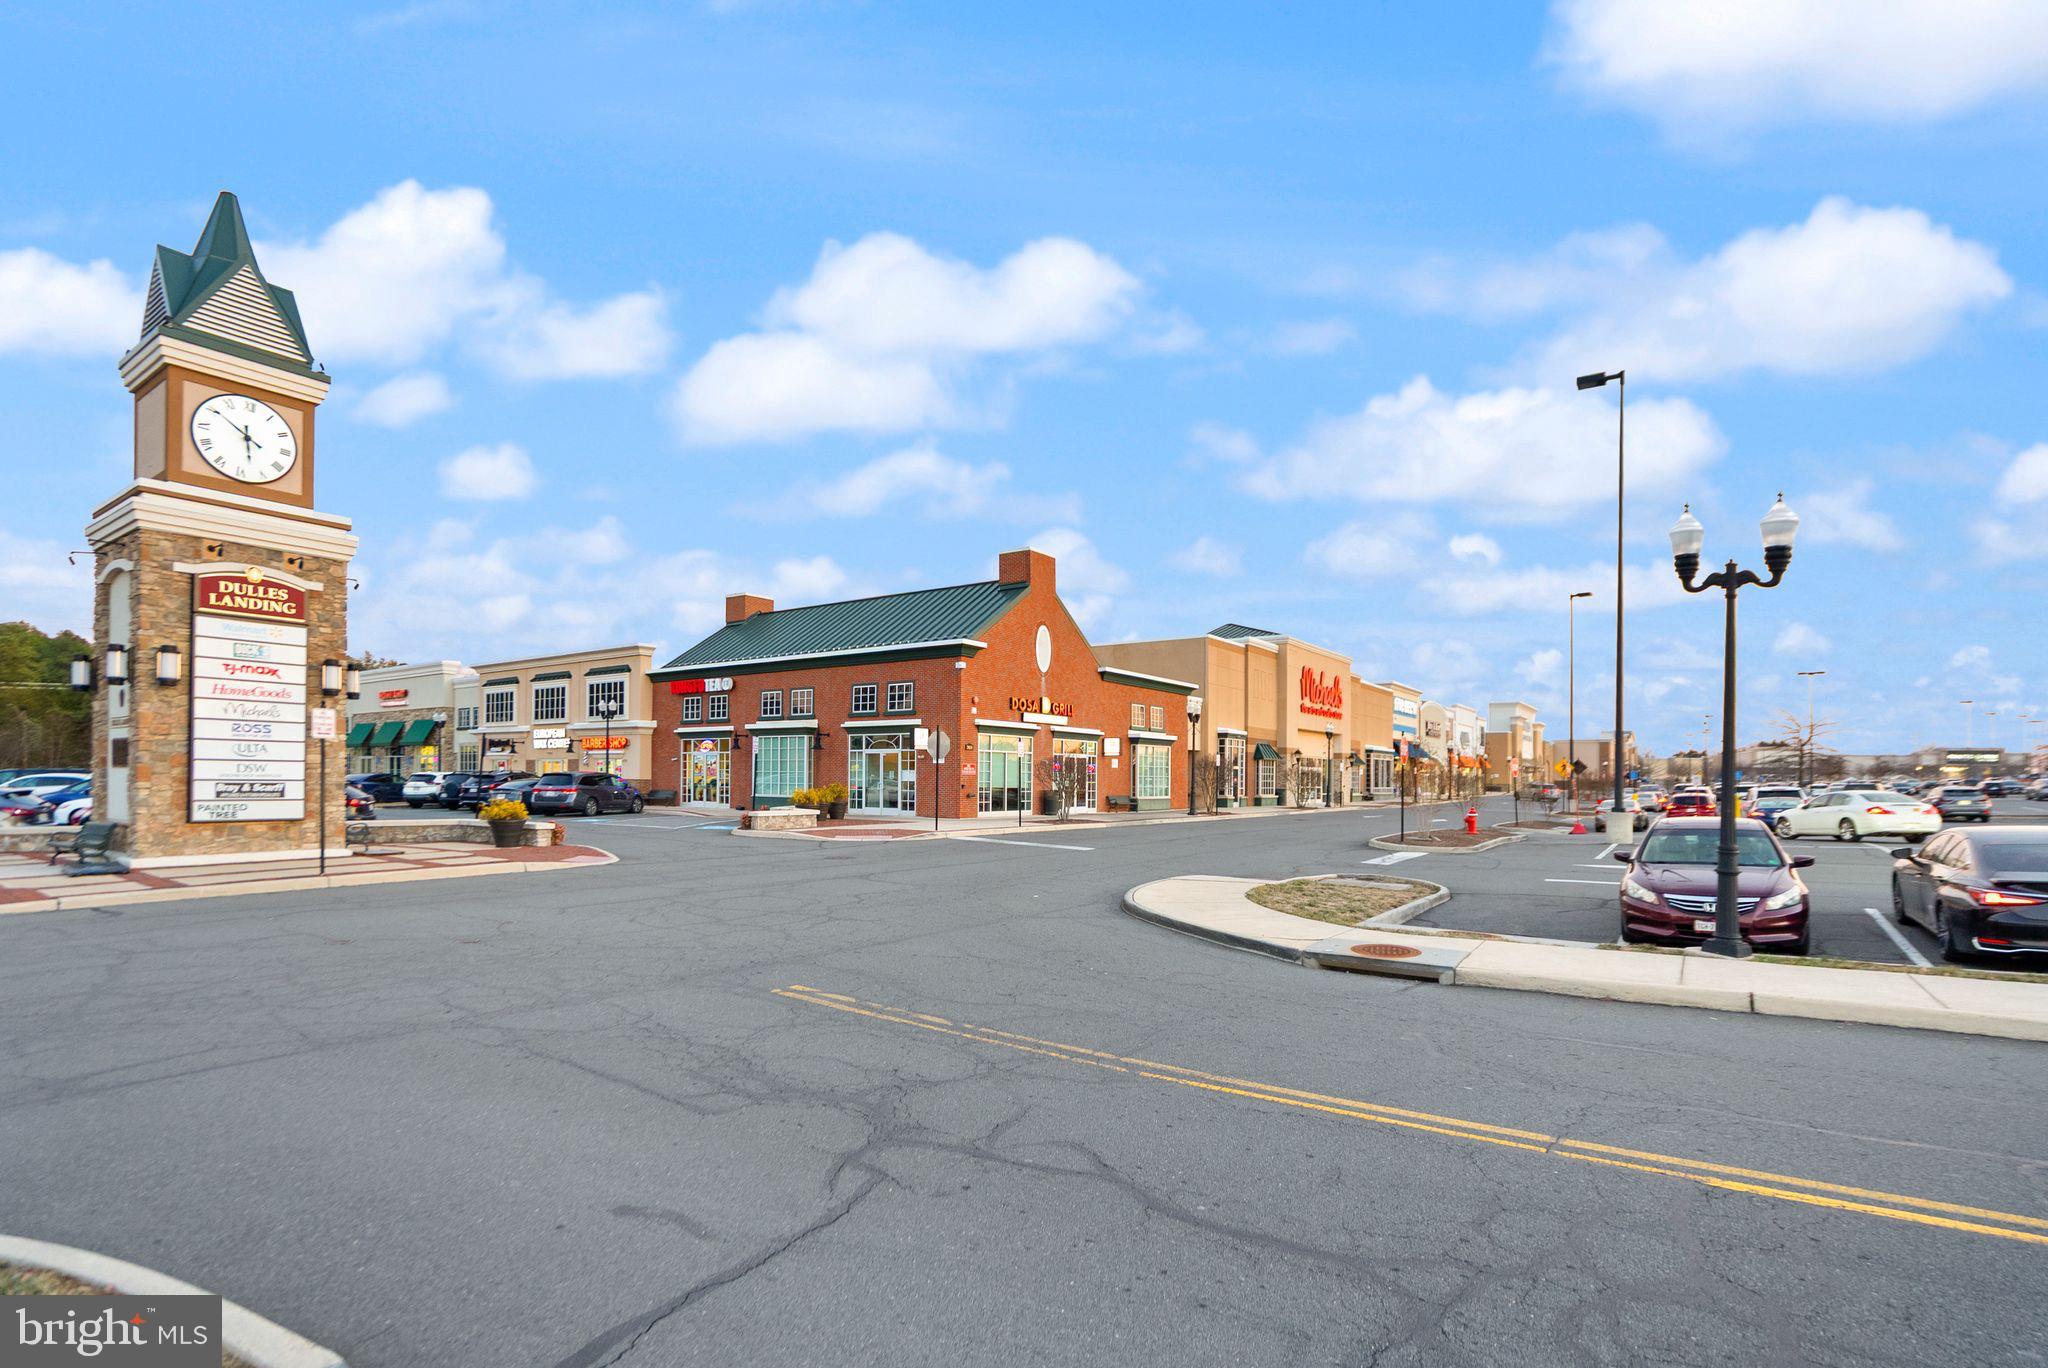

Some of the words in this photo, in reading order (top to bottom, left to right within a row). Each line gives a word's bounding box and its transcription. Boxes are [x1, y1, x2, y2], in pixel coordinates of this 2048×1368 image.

[218, 580, 289, 601] DULLES
[208, 592, 297, 615] LANDING
[210, 683, 294, 700] HomeGoods
[1300, 665, 1343, 709] Michaels
[1010, 696, 1040, 713] DOSA
[231, 722, 272, 734] ROSS
[236, 743, 268, 754] ULTA
[236, 763, 268, 773] DSW
[197, 803, 249, 812] PAINTED
[208, 811, 239, 819] TREE
